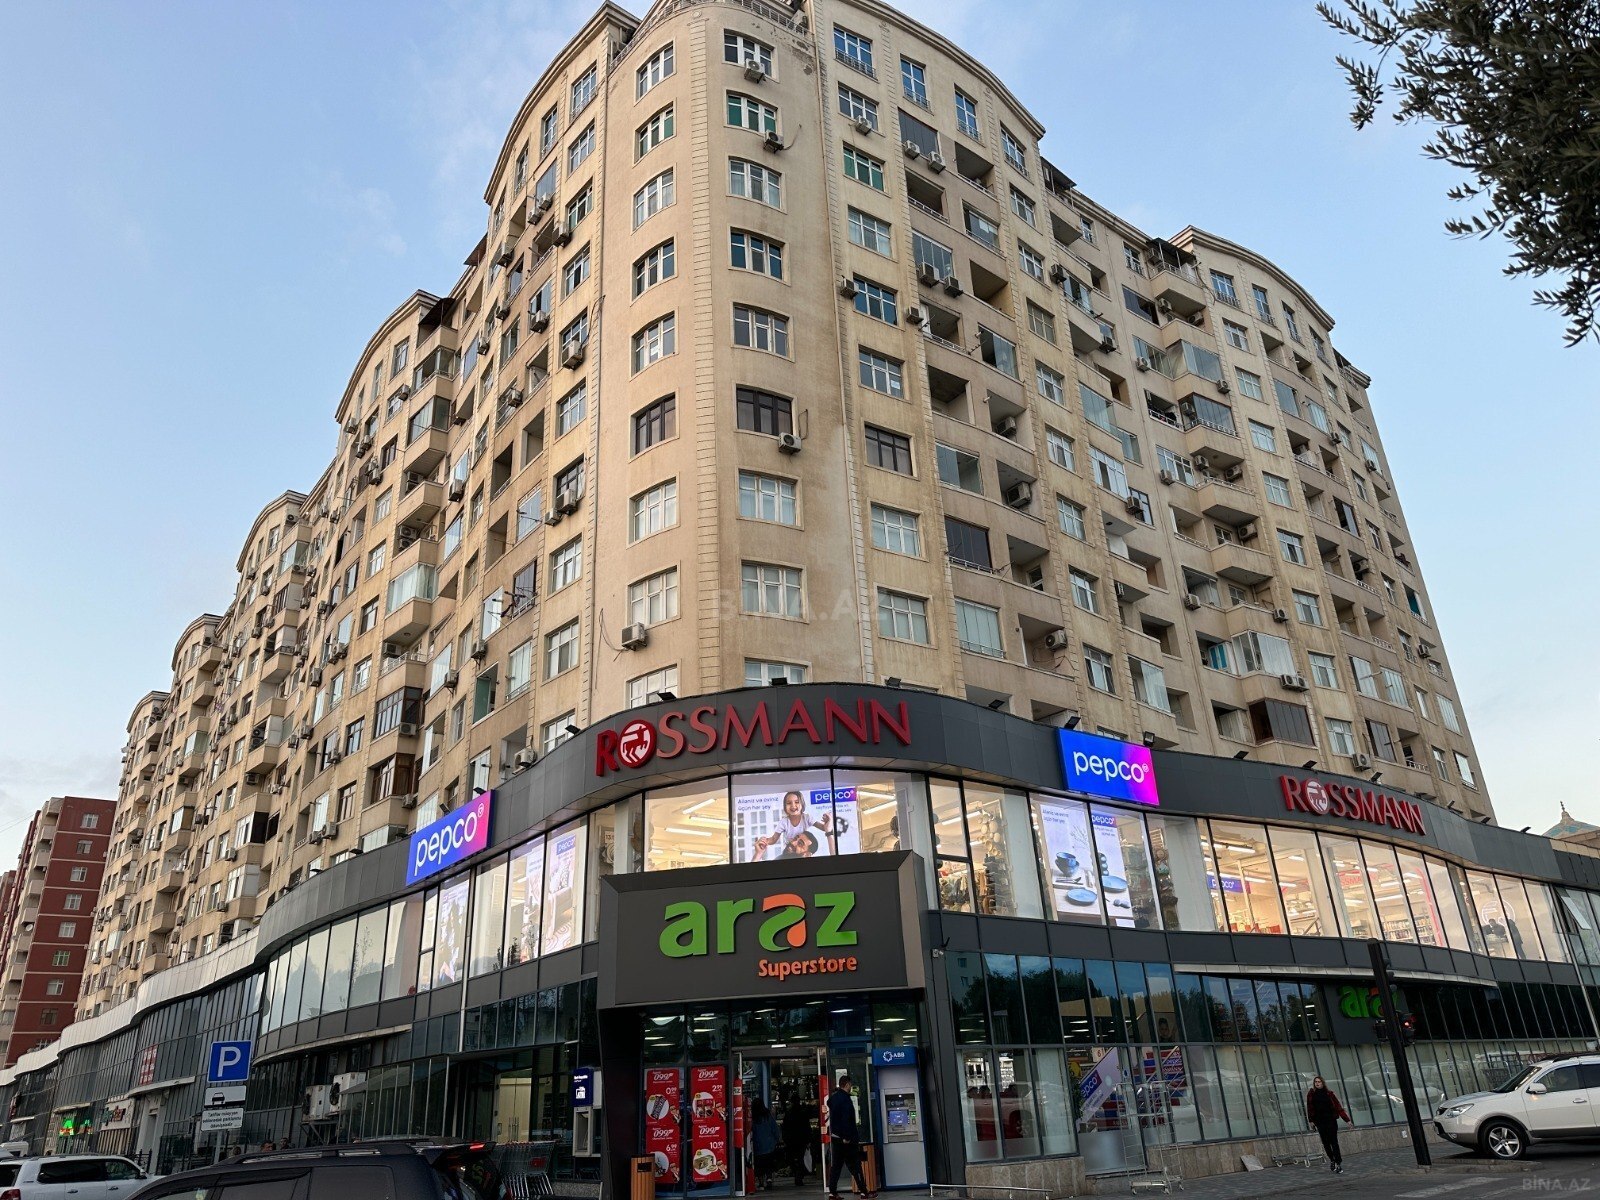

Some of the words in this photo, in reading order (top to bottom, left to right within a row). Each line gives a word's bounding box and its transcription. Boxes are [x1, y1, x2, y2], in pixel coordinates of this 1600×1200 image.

[595, 697, 912, 777] ROSSMANN
[1280, 775, 1425, 835] ROSSMANN
[659, 891, 858, 958] araz
[758, 955, 858, 981] Superstore
[217, 1046, 241, 1078] P
